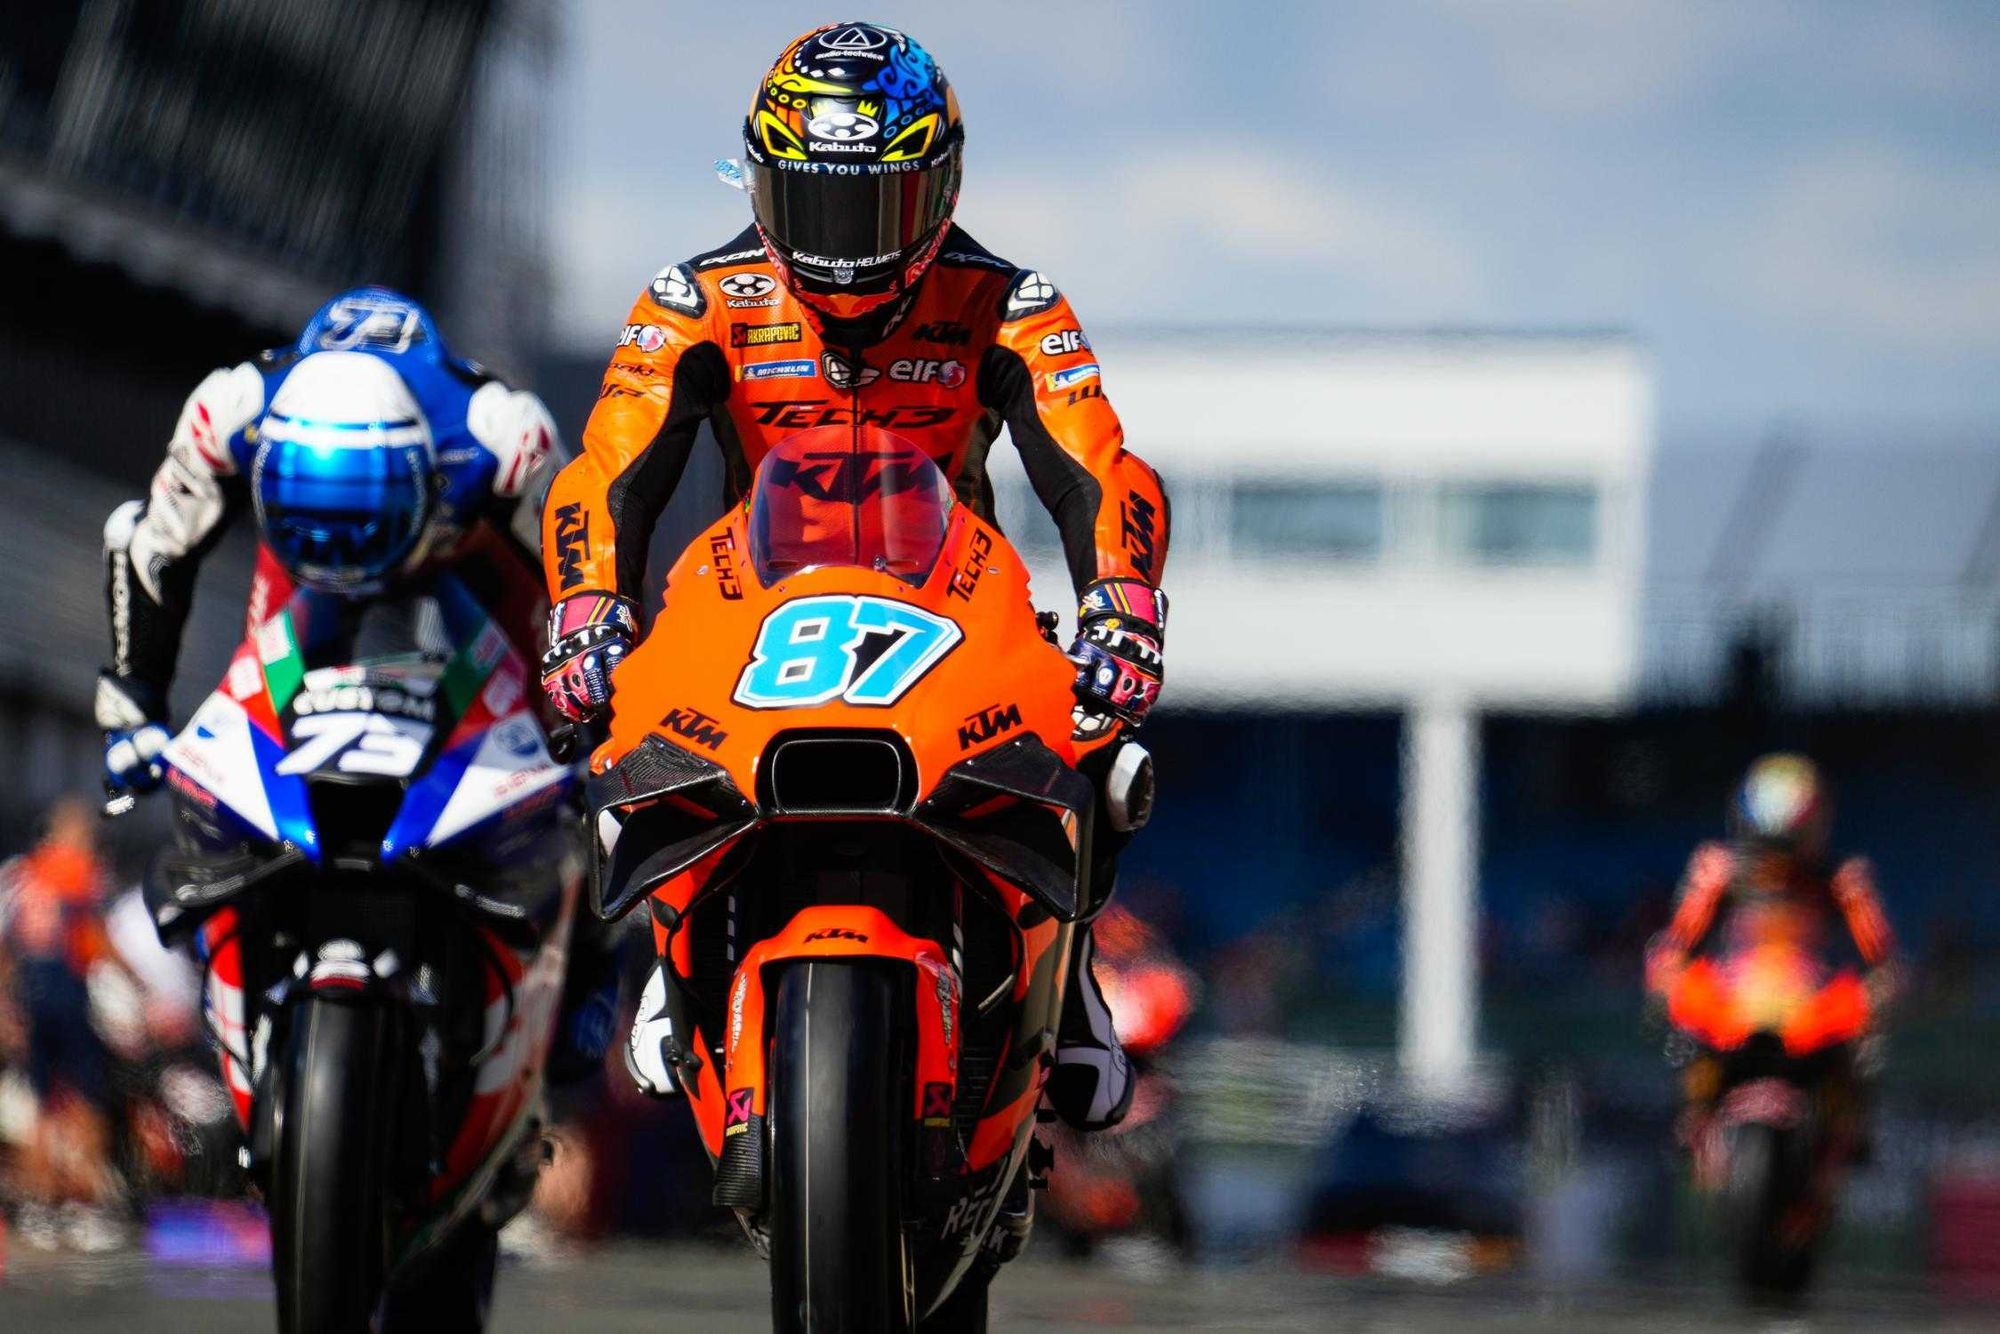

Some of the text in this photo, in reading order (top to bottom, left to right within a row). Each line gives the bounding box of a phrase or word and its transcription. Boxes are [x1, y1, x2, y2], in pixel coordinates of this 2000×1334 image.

[815, 50, 884, 60] audio-technica
[809, 141, 876, 153] Kabuto
[777, 159, 920, 176] GIVES YOU WINGS
[792, 251, 855, 268] Kabuto
[726, 297, 780, 308] Kabuto
[913, 320, 971, 346] KTM
[756, 364, 810, 376] MICHELIN
[889, 359, 939, 382] elf
[554, 501, 591, 593] KTM
[1119, 489, 1155, 584] KTM
[710, 526, 744, 601] TECH3
[945, 527, 993, 602] TECH3
[731, 594, 965, 710] 87
[658, 706, 729, 750] KTM
[957, 704, 1024, 752] KTM
[803, 927, 869, 944] KTM
